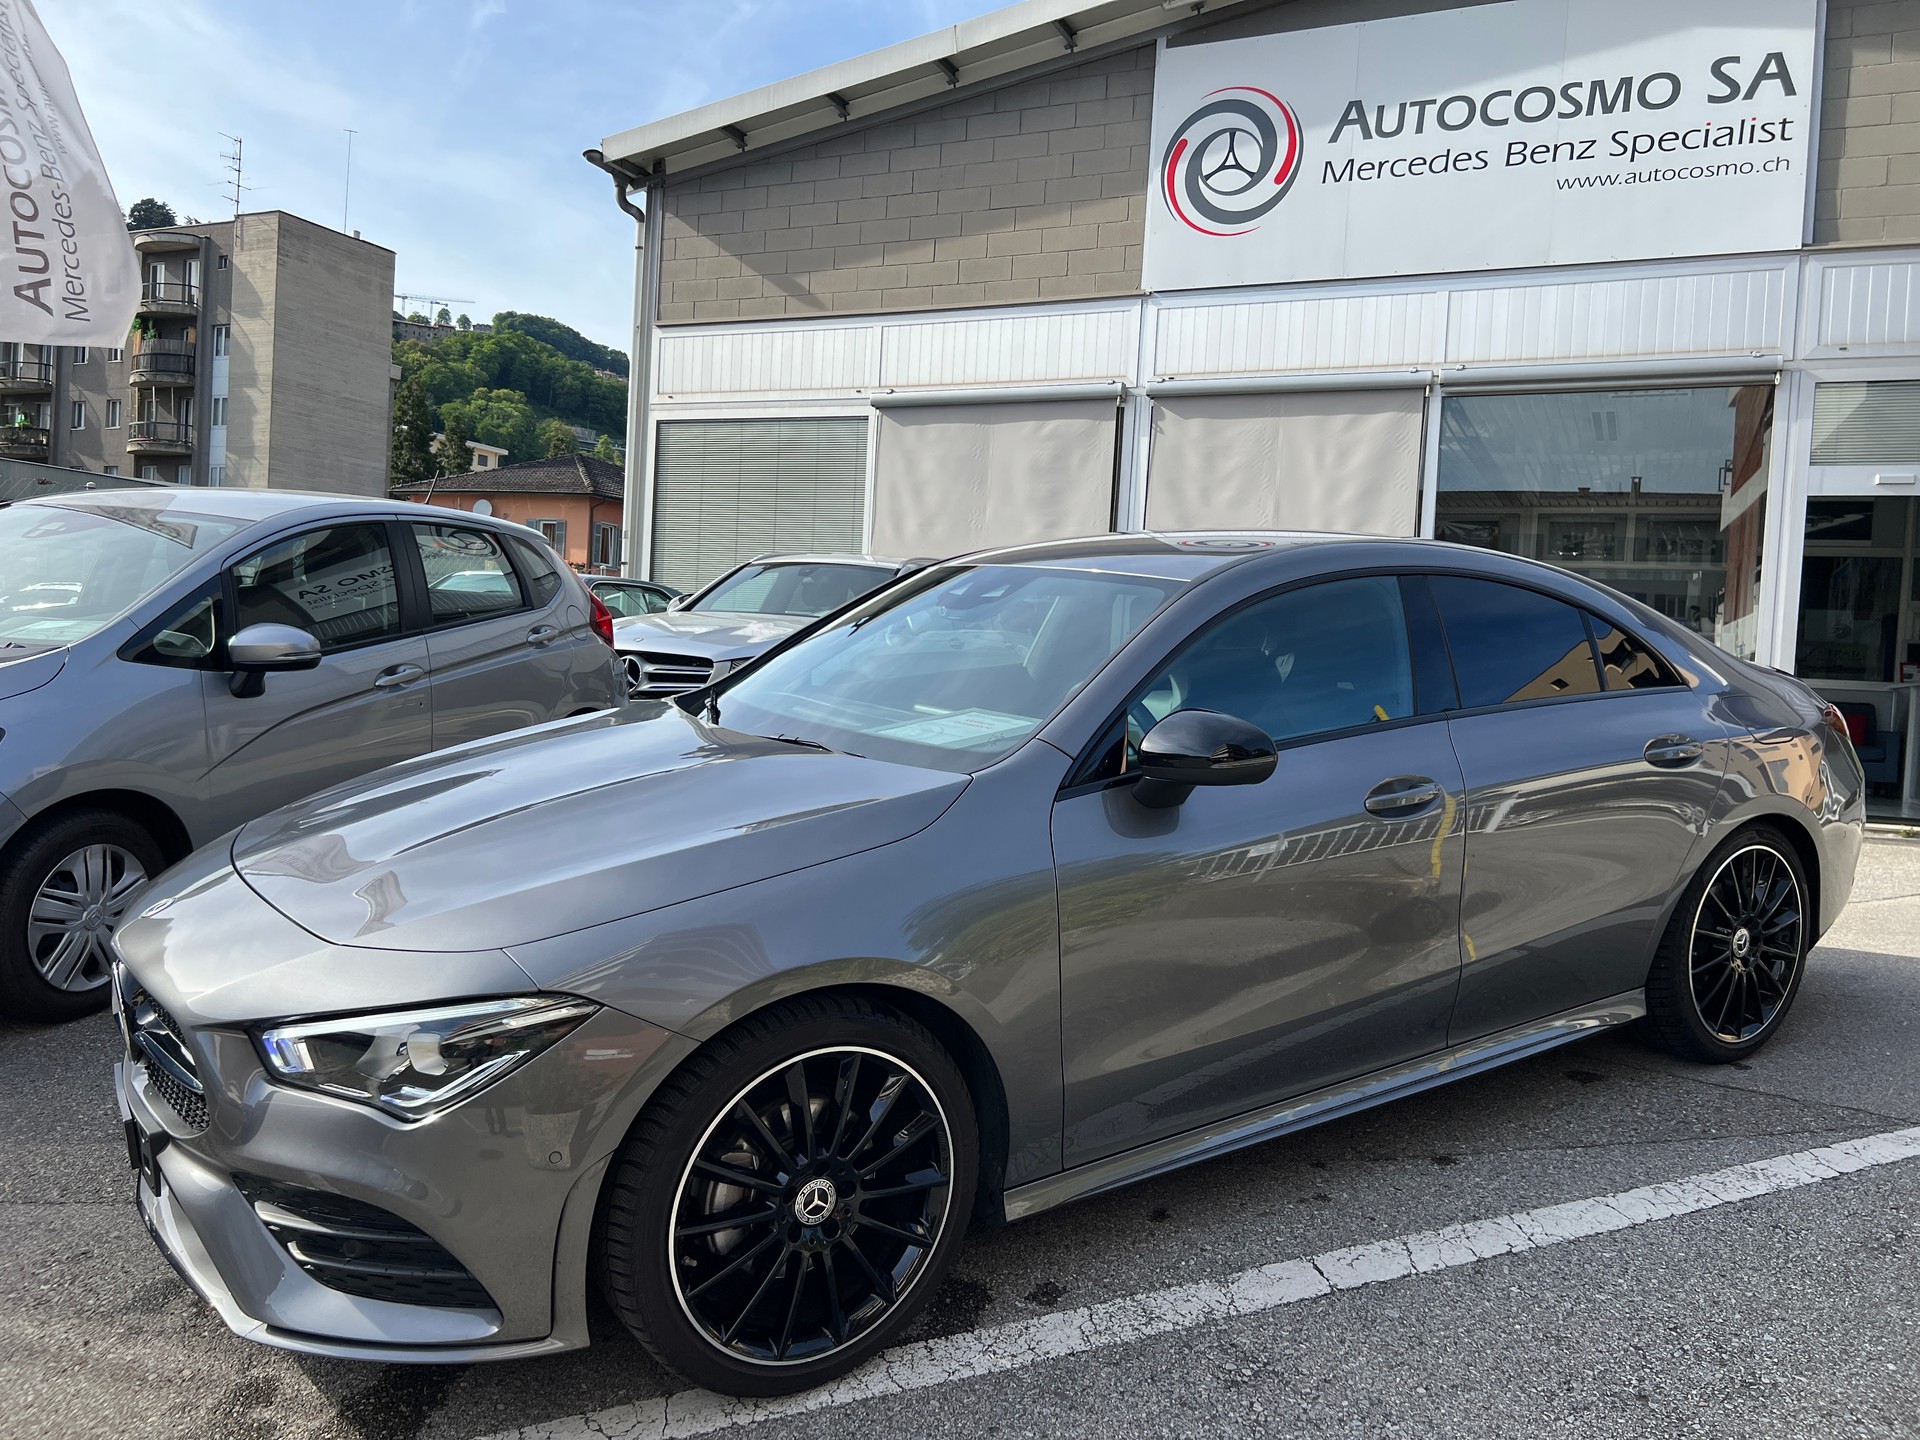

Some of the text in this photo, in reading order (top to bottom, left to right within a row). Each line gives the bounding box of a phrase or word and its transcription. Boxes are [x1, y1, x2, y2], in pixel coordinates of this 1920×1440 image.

[1708, 52, 1797, 103] SA
[1321, 117, 1794, 184] Mercedes Benz Specialist
[1556, 156, 1790, 191] www.autocosmo.ch
[26, 119, 91, 322] Mercedes-Benz
